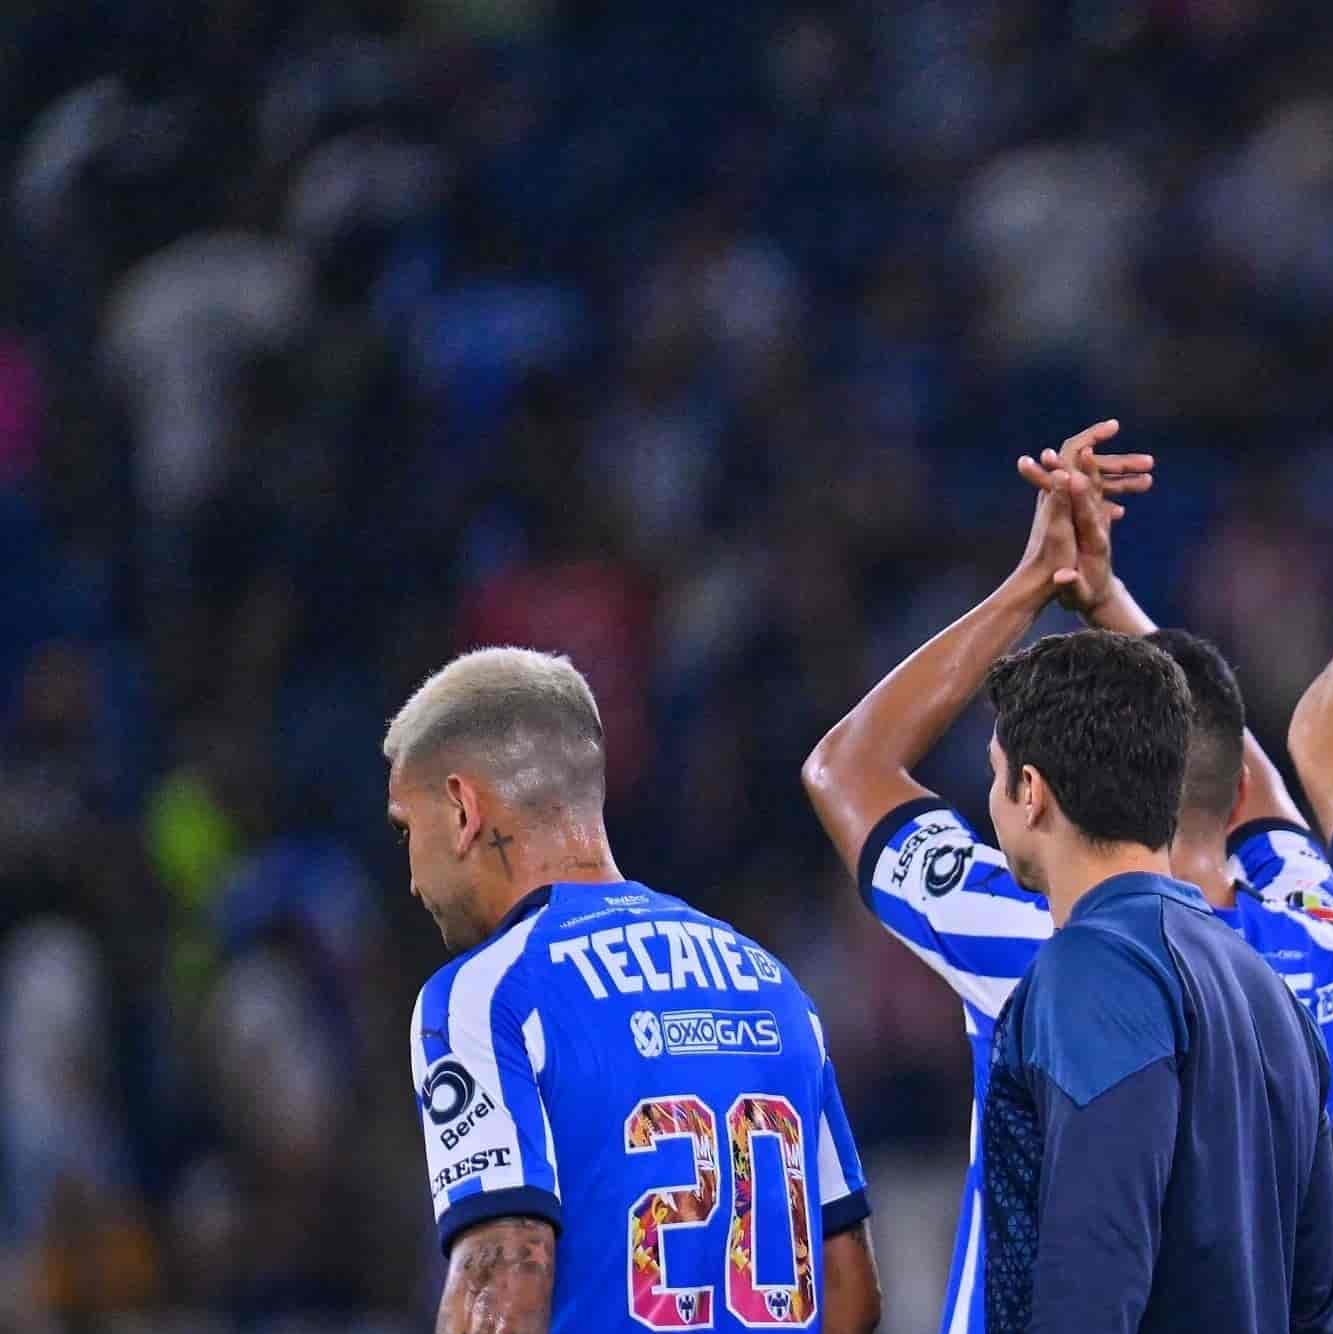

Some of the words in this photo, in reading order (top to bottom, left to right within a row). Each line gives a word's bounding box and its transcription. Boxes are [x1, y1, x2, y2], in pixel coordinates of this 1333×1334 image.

[548, 919, 760, 999] TECATE
[439, 1092, 496, 1152] Berel
[625, 1094, 818, 1331] 20
